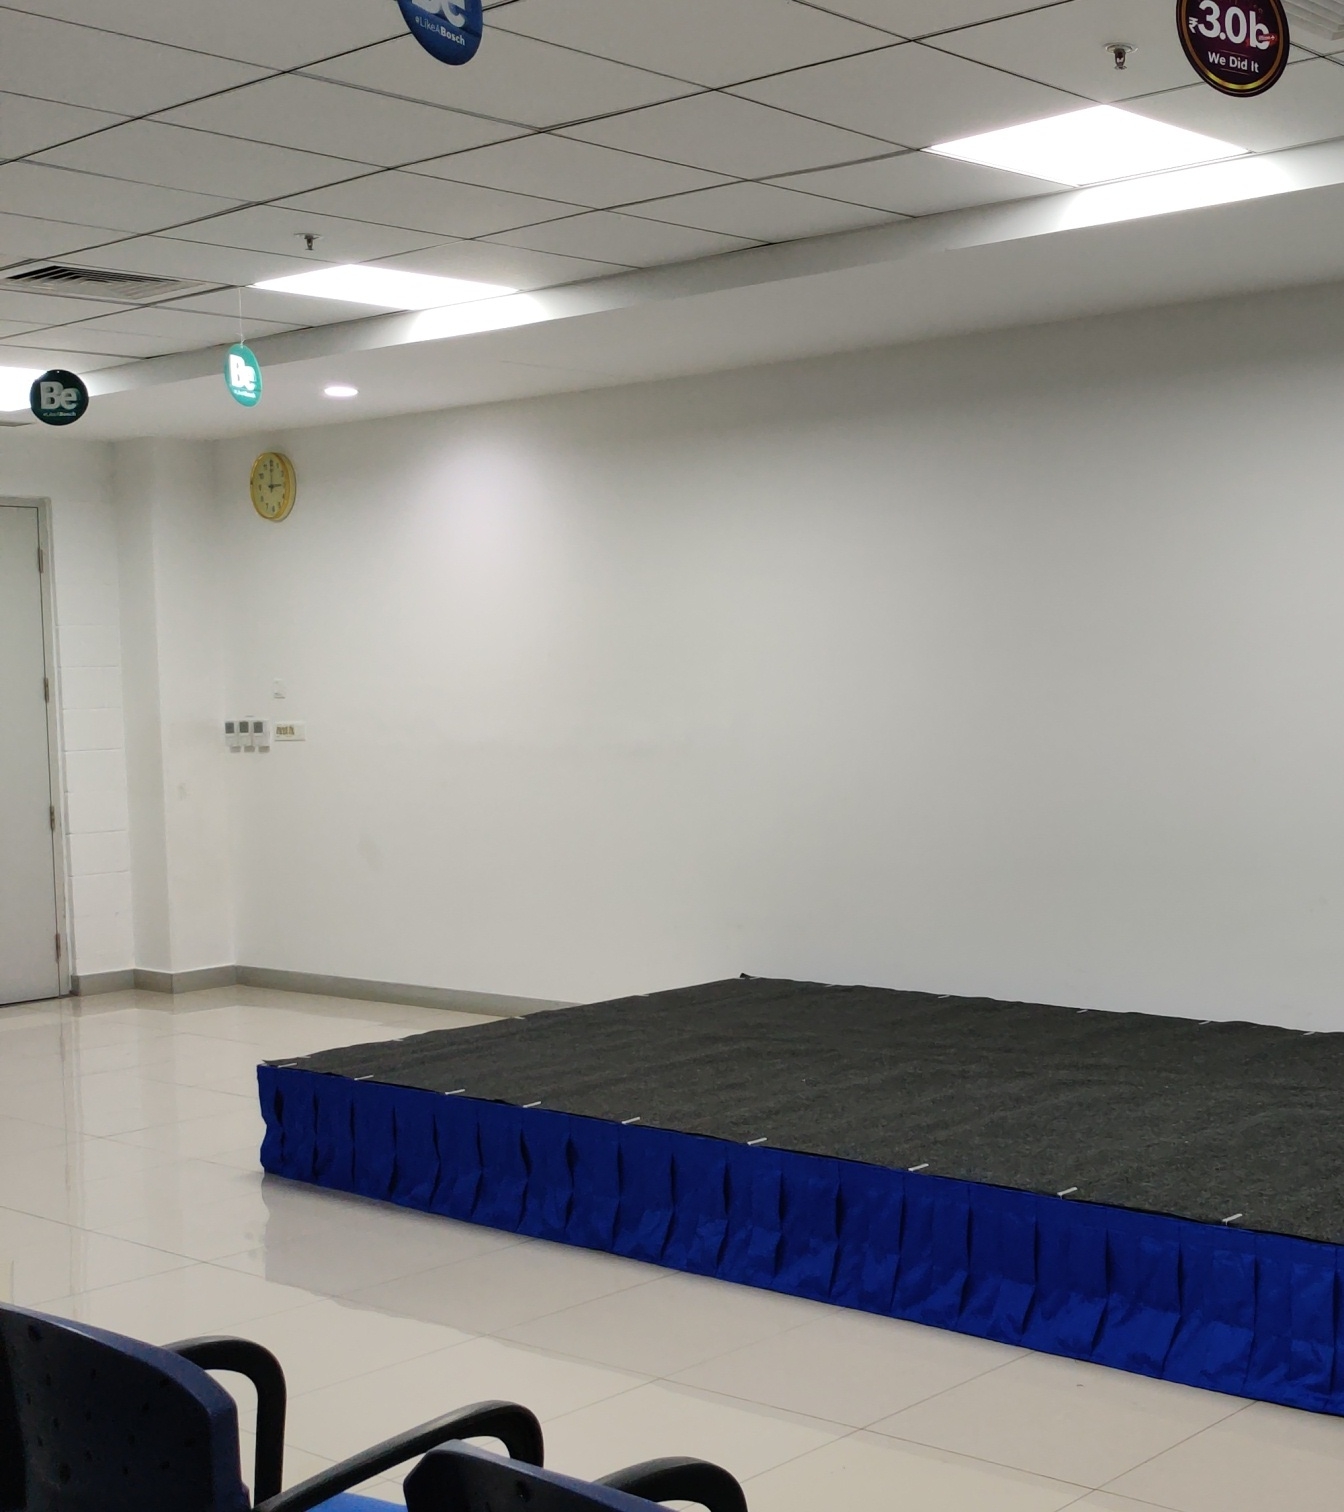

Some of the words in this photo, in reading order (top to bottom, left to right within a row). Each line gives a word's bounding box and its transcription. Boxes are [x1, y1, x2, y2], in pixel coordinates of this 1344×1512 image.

[1208, 51, 1226, 66] We
[1229, 56, 1248, 71] Did
[1251, 60, 1260, 73] It
[228, 353, 258, 391] Be
[40, 380, 80, 410] Be
